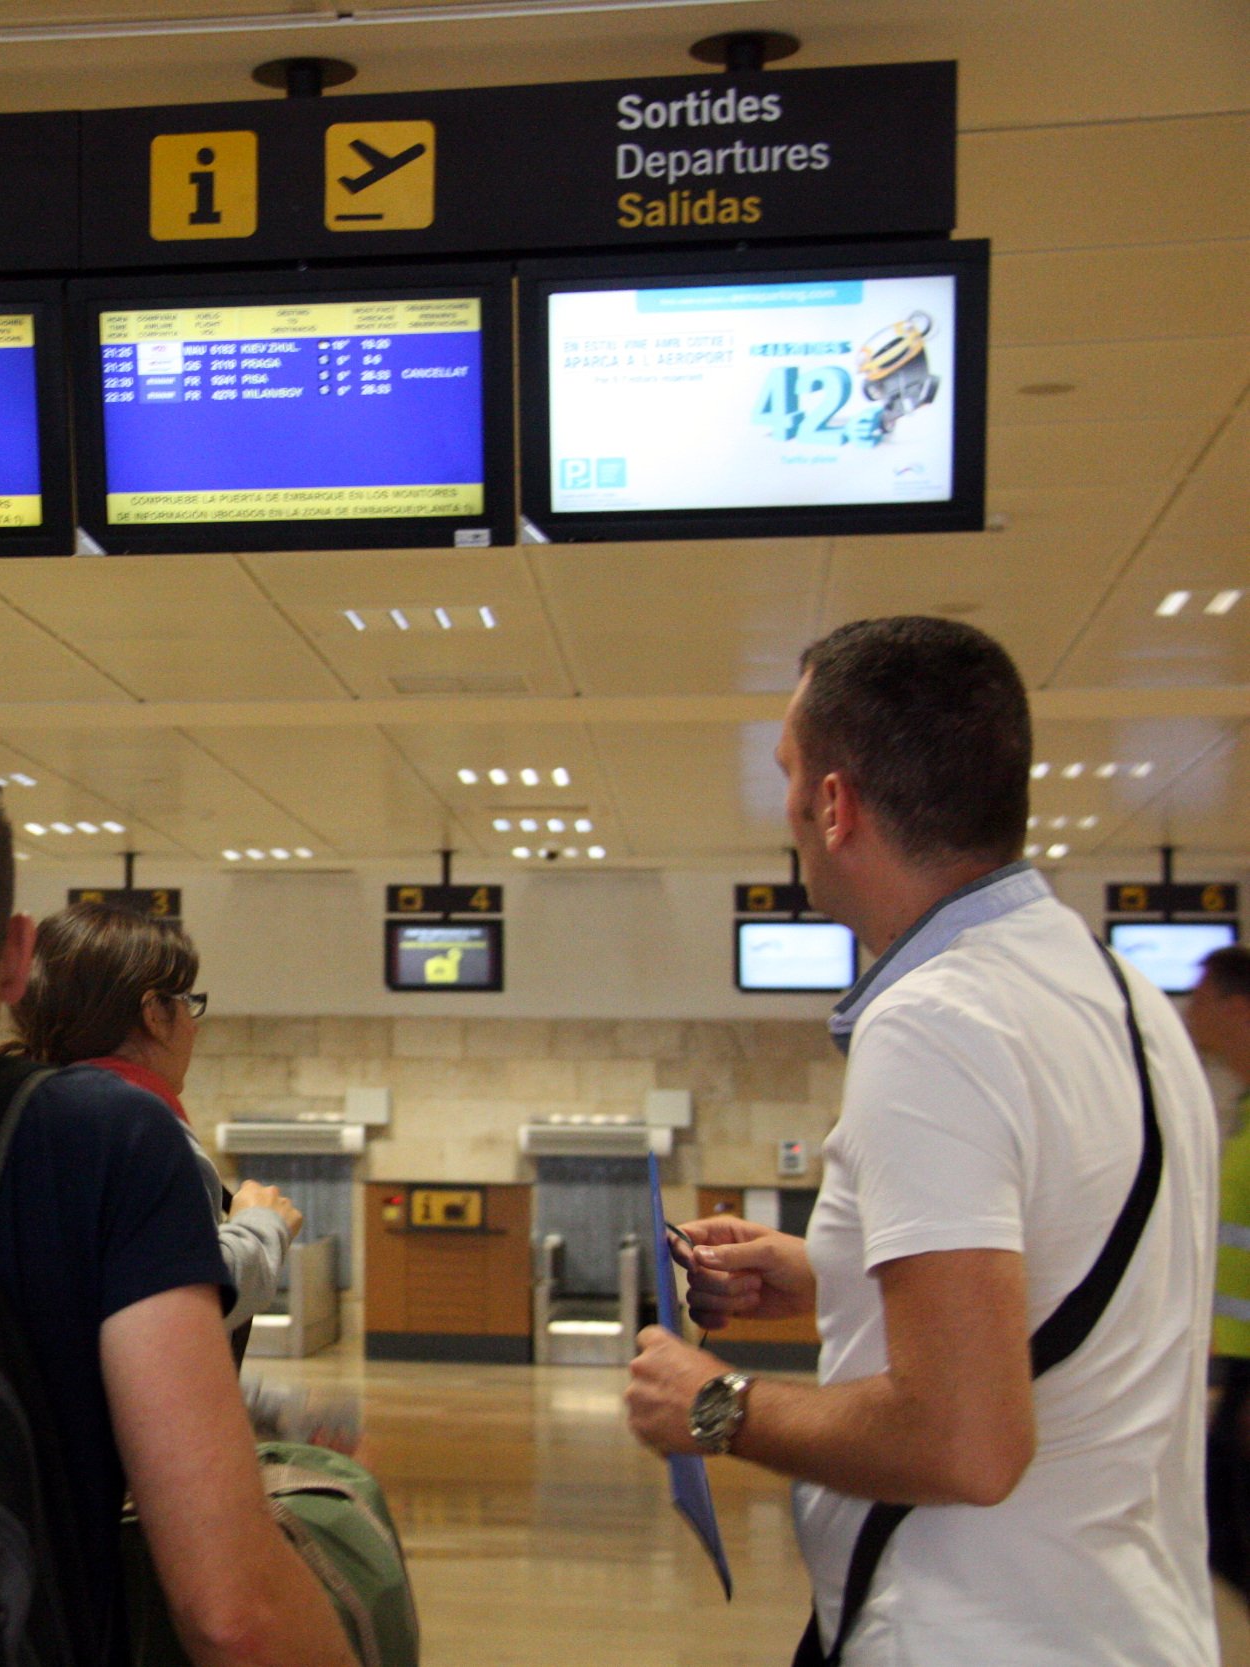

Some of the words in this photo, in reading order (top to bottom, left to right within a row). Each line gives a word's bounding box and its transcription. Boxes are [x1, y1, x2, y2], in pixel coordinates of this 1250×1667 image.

[613, 87, 782, 130] Sortides
[616, 140, 830, 184] Departures
[617, 189, 763, 228] Salidas
[241, 358, 281, 370] PRAGA
[564, 353, 619, 369] APARCA
[184, 376, 200, 386] FR
[184, 390, 200, 400] FR
[202, 494, 215, 503] LA
[220, 493, 261, 503] PUERTA
[393, 488, 457, 498] MONITORES
[152, 890, 169, 916] 3
[469, 886, 489, 911] 4
[1201, 885, 1225, 911] 6
